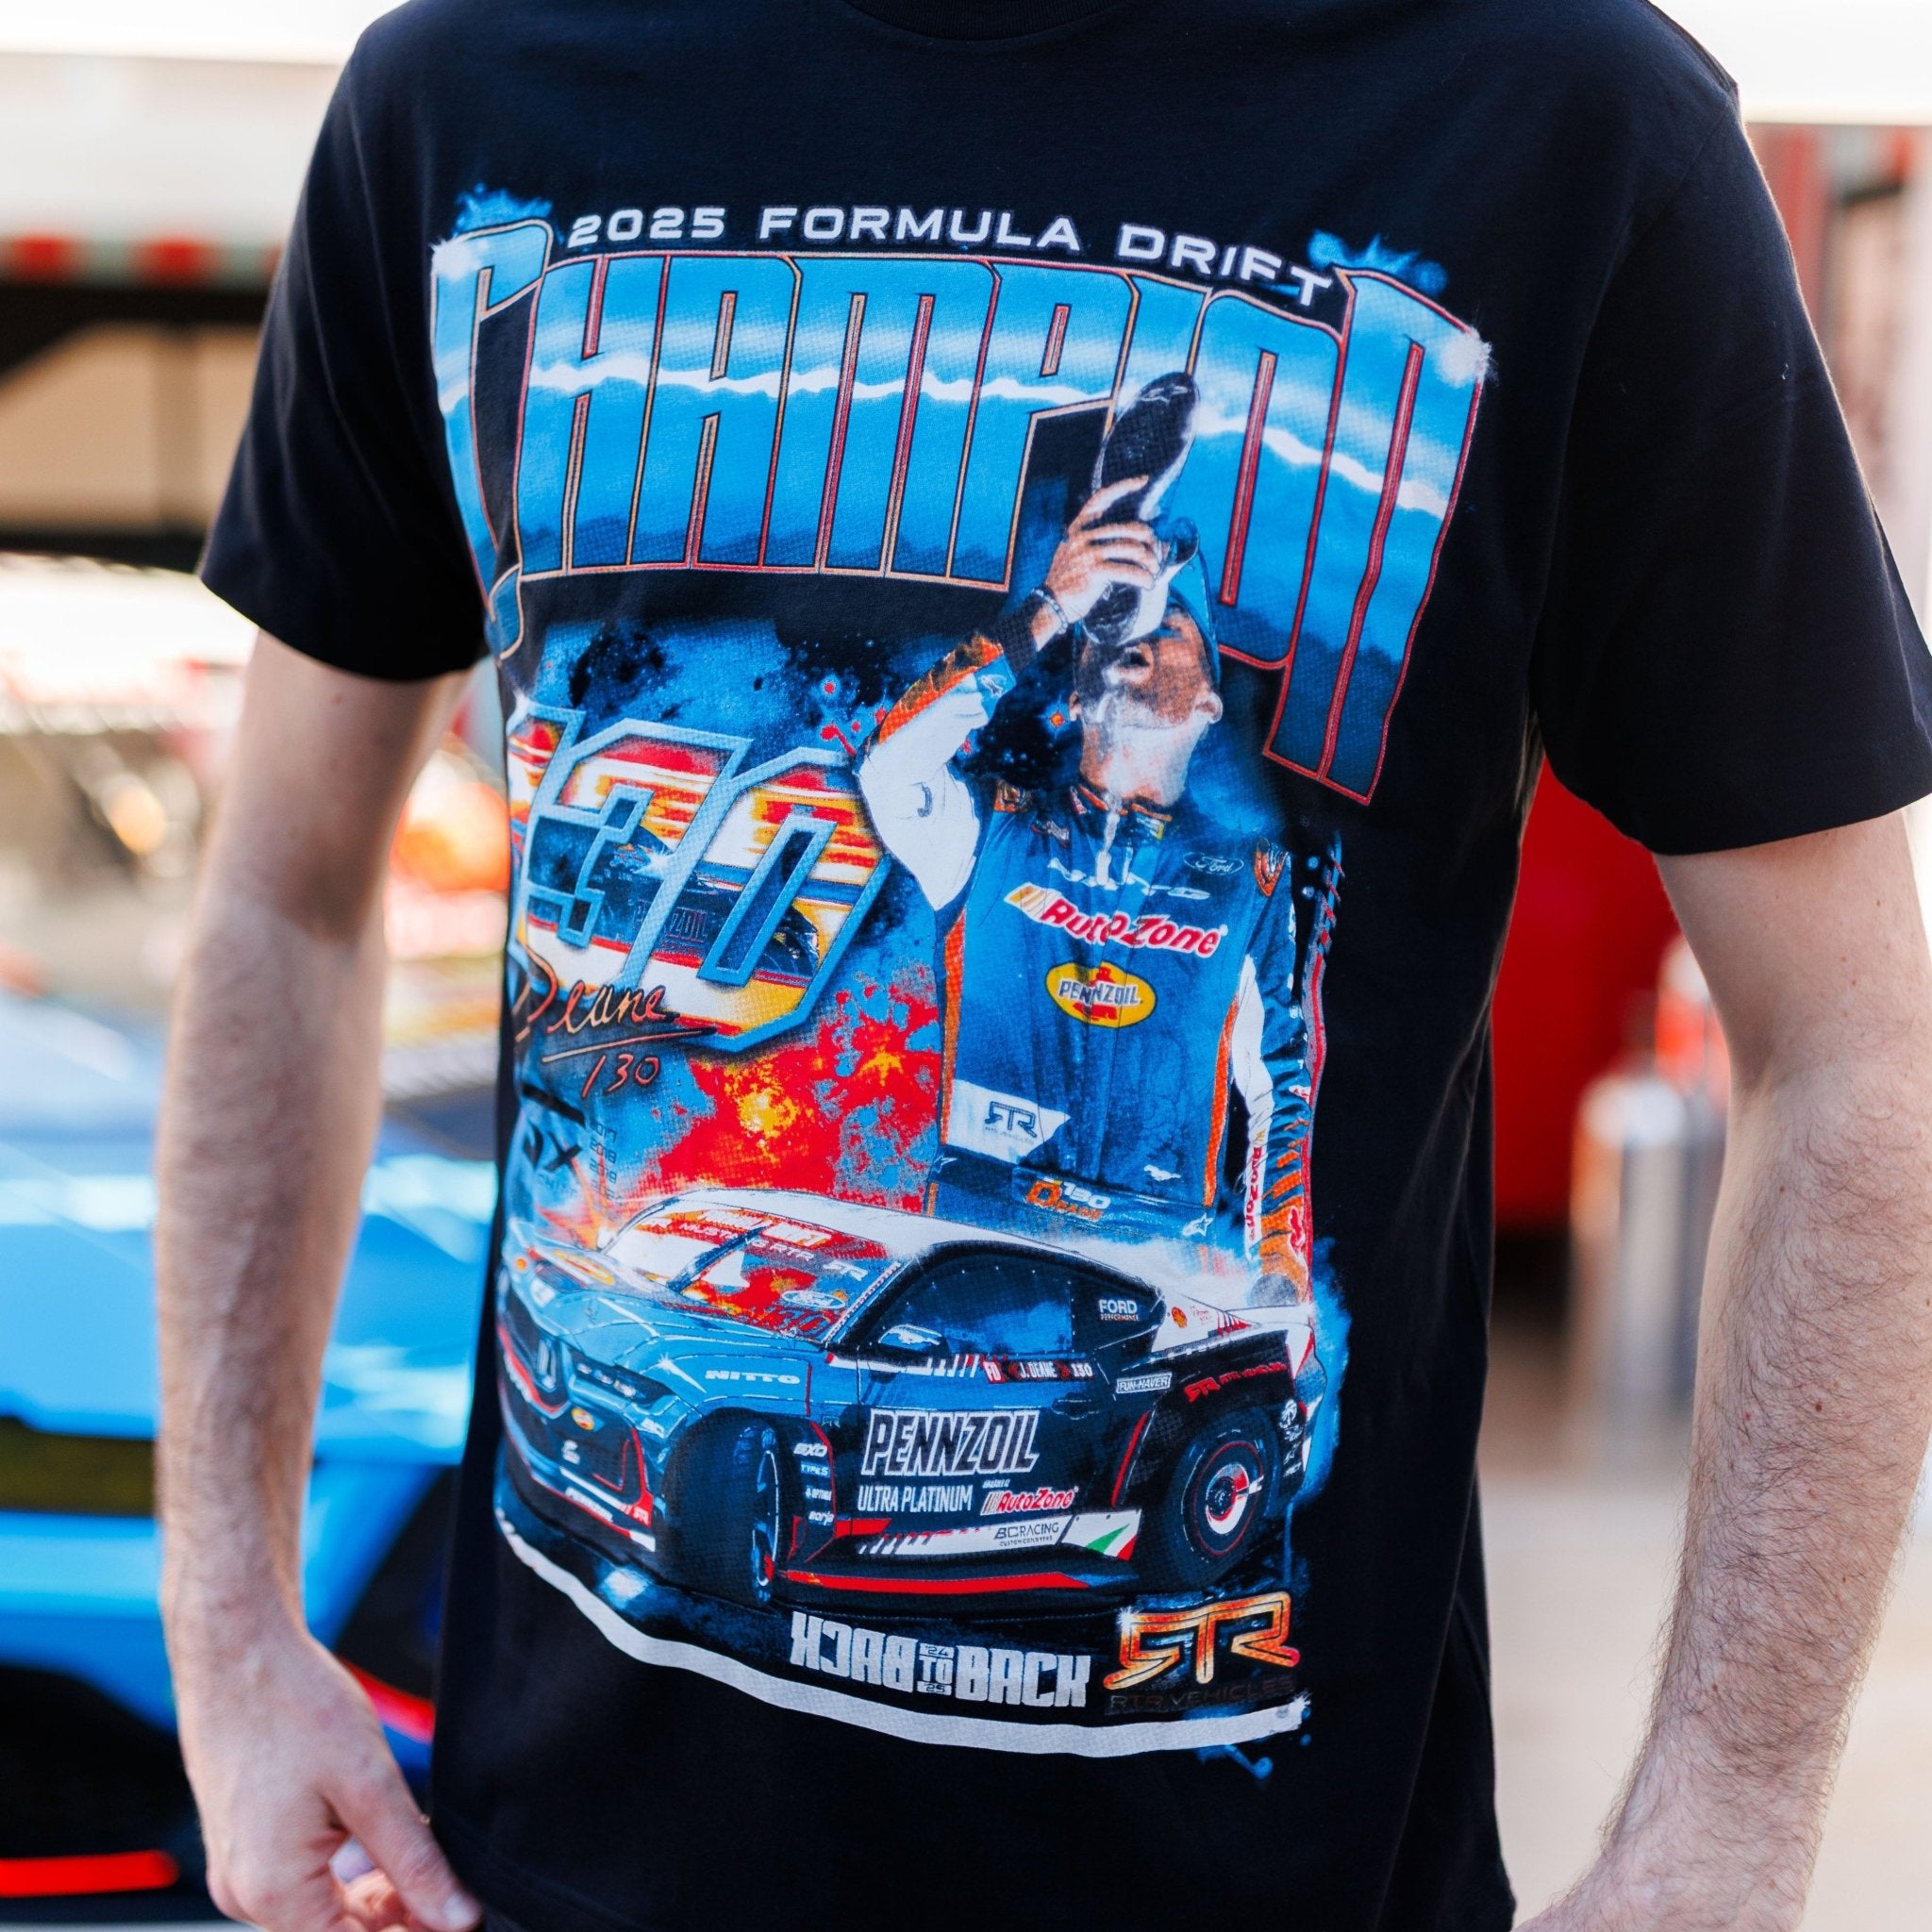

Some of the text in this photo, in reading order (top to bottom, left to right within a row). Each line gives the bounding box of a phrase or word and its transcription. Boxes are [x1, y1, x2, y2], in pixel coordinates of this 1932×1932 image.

[567, 207, 1335, 308] 2025 FORMULA DRIFT
[1039, 896, 1224, 958] AutoZone
[1058, 977, 1140, 1007] PENNZOIL
[581, 1053, 660, 1100] 130
[1063, 1181, 1111, 1209] 130
[1099, 1299, 1138, 1314] FORD
[705, 1370, 801, 1385] NITTO
[860, 1409, 1041, 1476] PENNZOIL
[858, 1484, 974, 1513] ULTRA PLATINUM
[996, 1486, 1075, 1513] AutoZone
[919, 1655, 954, 1685] TO
[956, 1644, 1091, 1707] BACK
